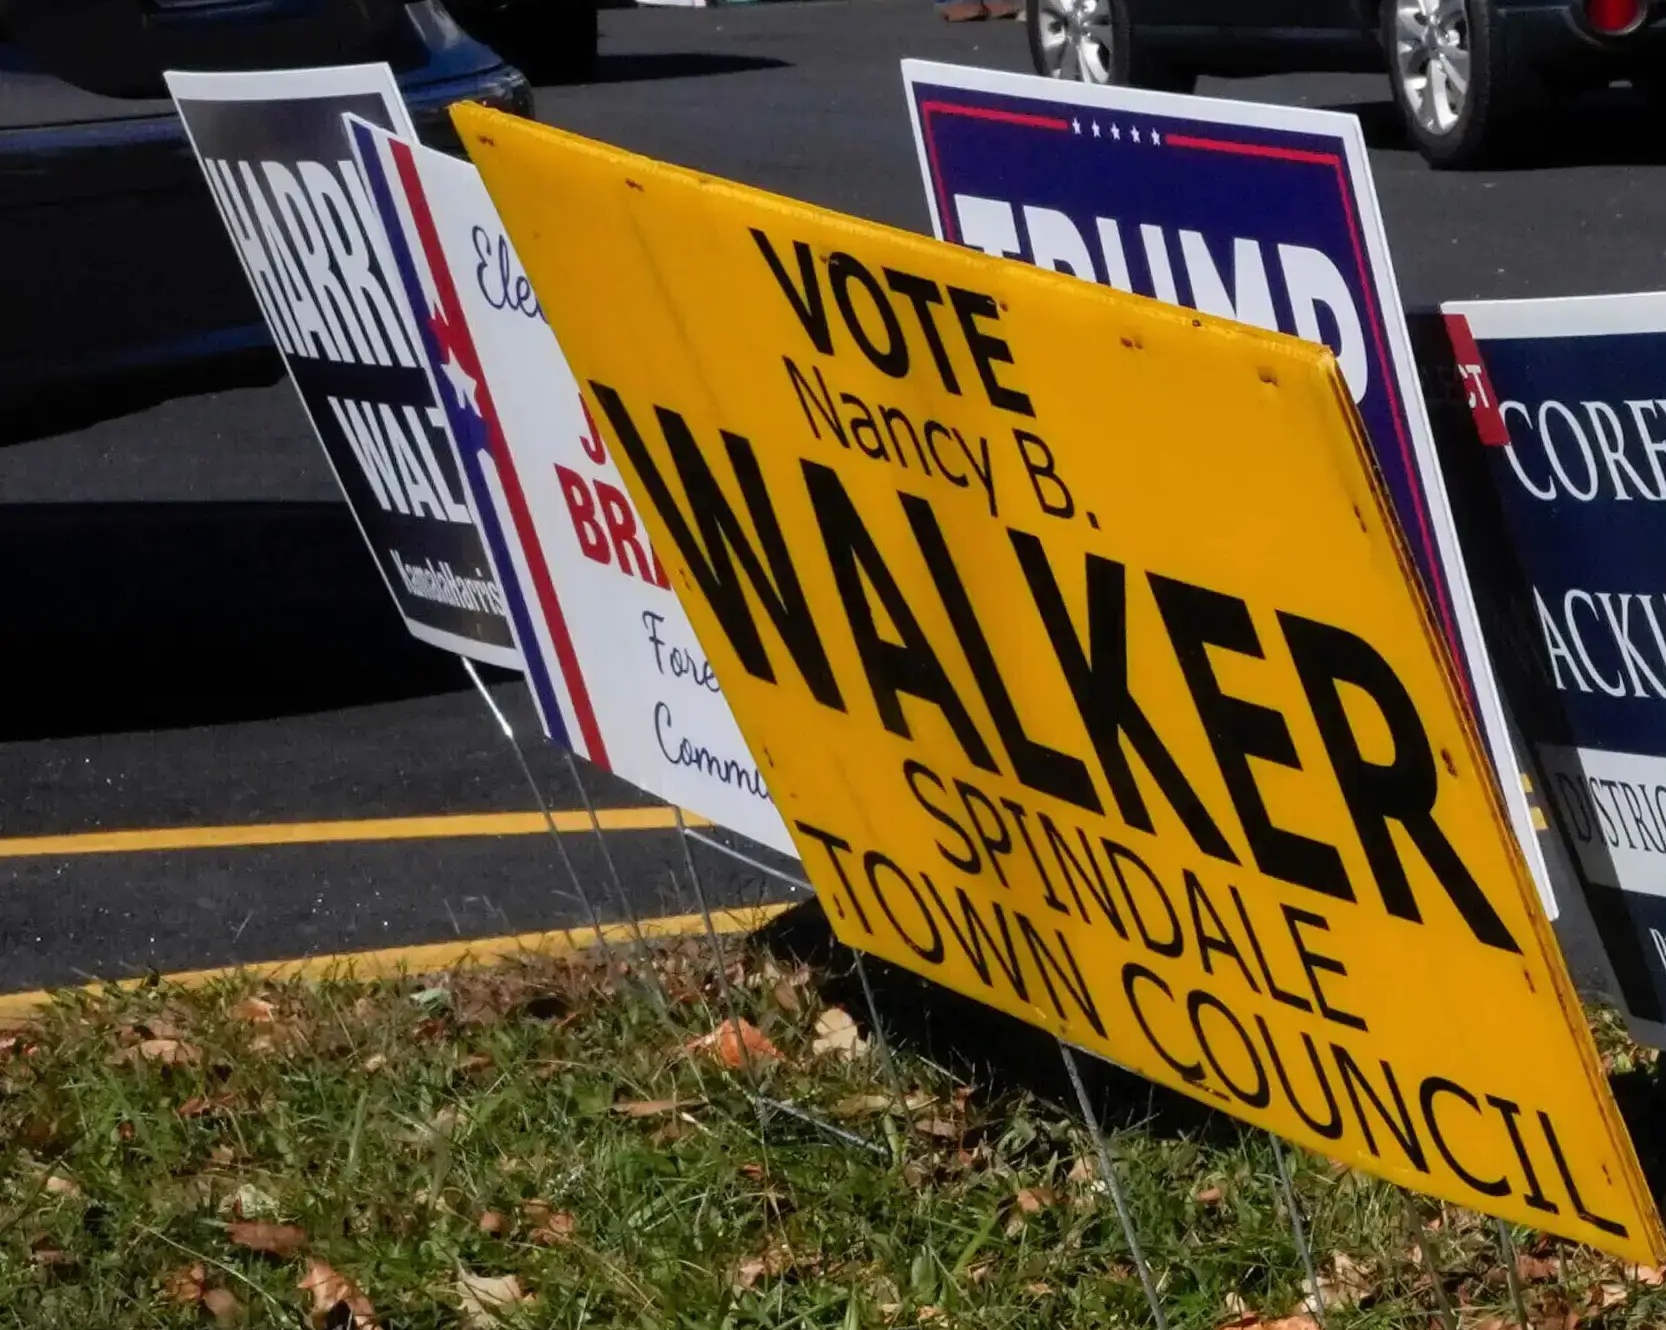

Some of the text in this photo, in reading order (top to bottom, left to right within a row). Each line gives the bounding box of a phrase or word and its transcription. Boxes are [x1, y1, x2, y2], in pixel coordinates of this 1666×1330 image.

[204, 158, 428, 369] HARRI
[471, 225, 551, 324] Ele
[749, 226, 1034, 417] VOTE
[782, 356, 1100, 531] Nancy B.
[390, 549, 508, 618] KamalaHarris
[590, 381, 1519, 955] WALKER
[642, 610, 721, 694] Fore
[904, 760, 1369, 1032] SPINDALE
[797, 821, 1628, 1242] TOWN COUNCIL
